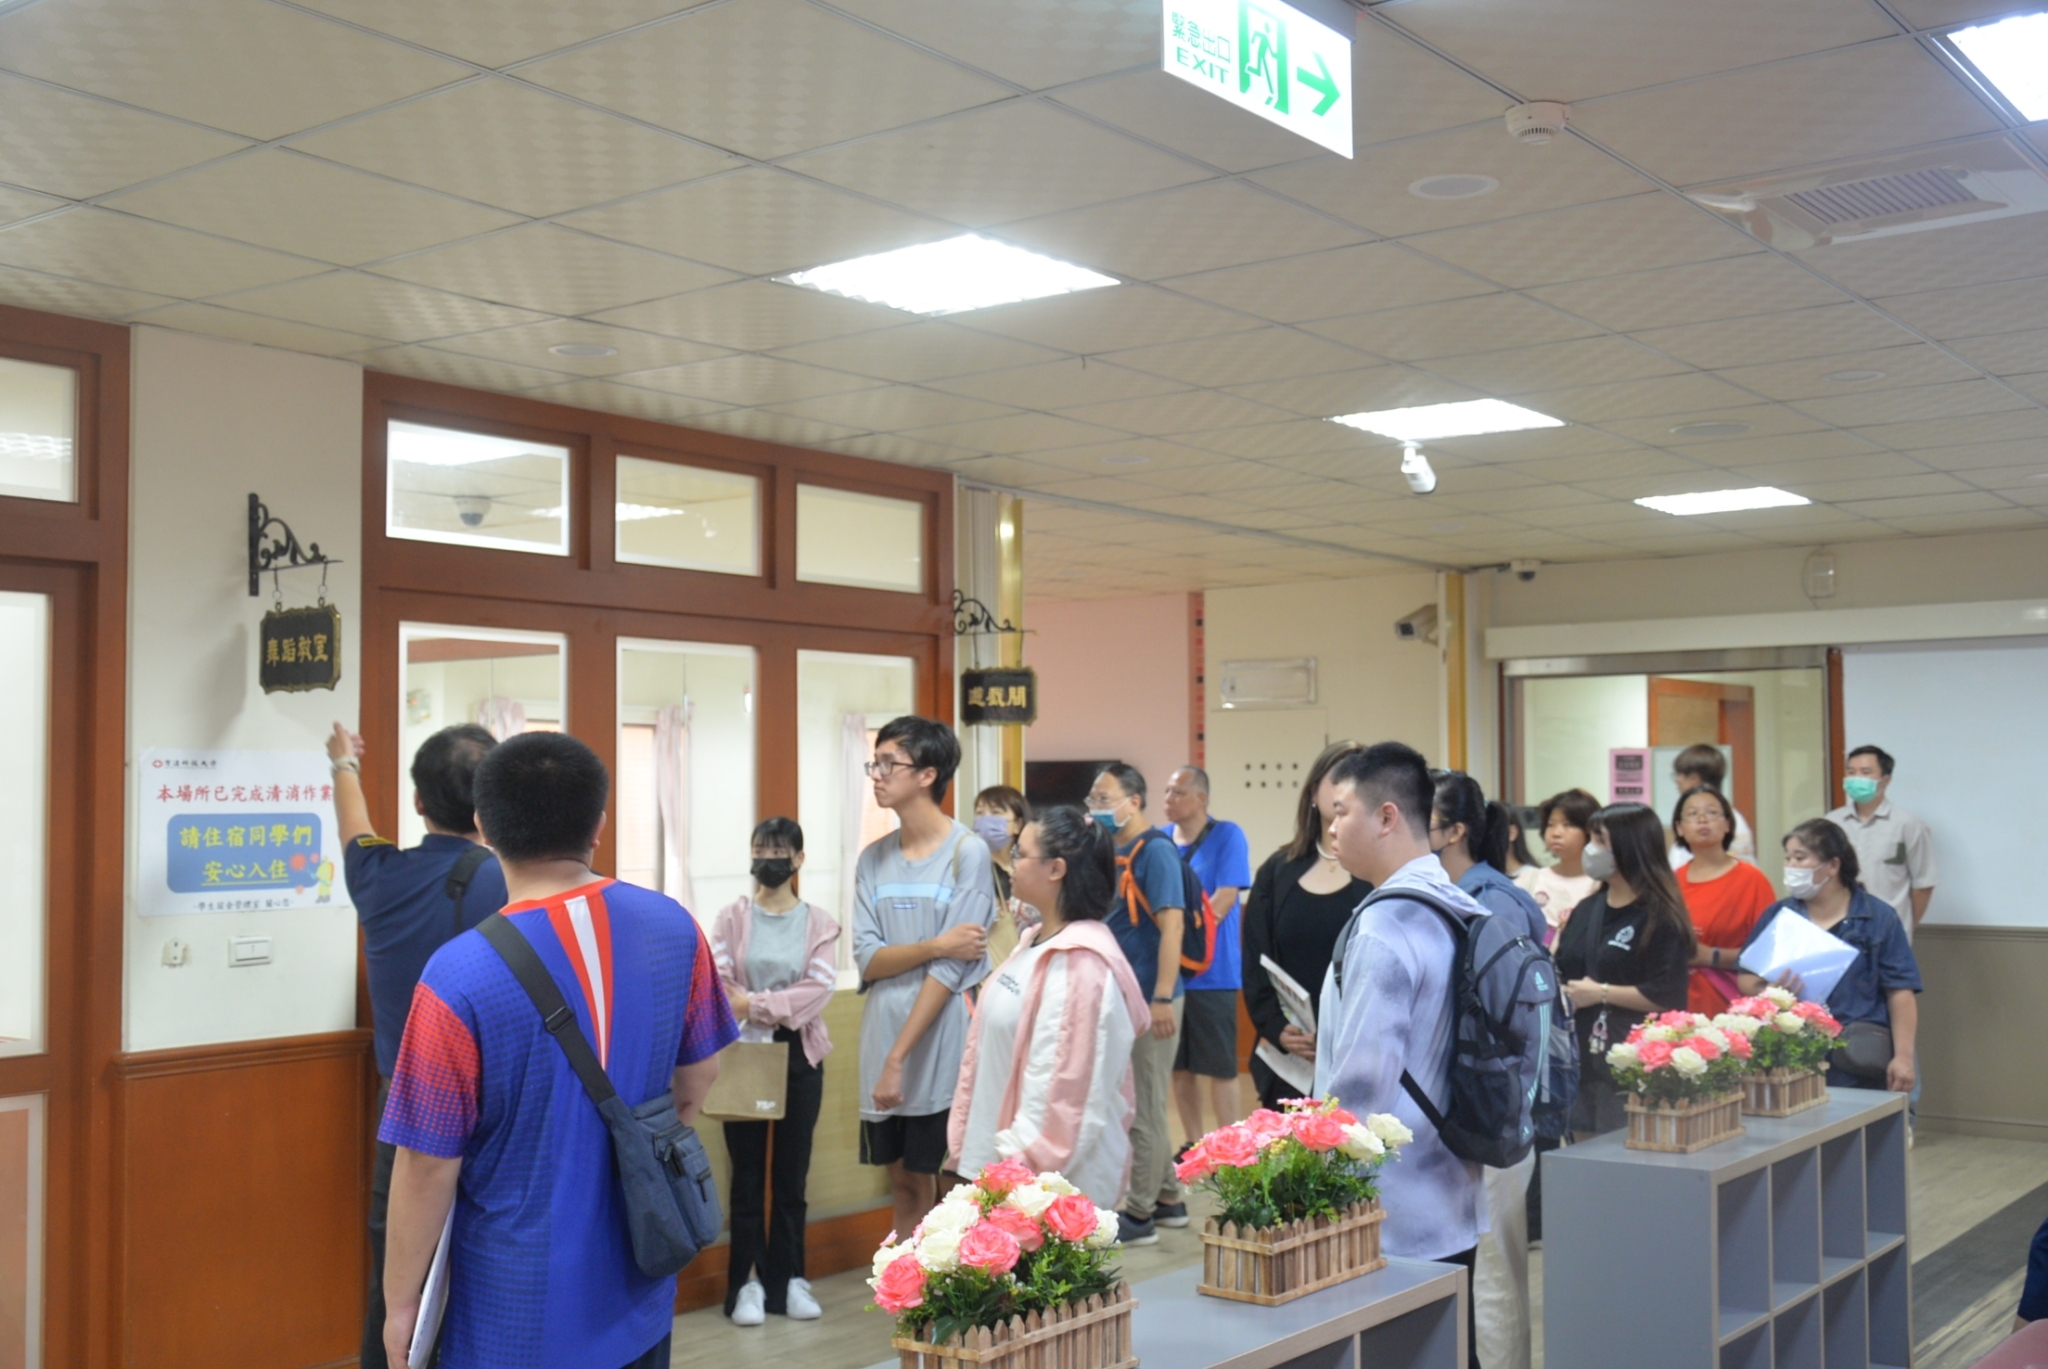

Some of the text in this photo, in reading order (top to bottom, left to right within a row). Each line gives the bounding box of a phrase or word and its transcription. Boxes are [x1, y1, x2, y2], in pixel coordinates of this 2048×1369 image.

[1171, 11, 1231, 64] 緊急出口
[1176, 46, 1229, 84] EXIT
[266, 633, 329, 667] 舞蹈教室
[157, 784, 333, 803] 本場所已完成清消作業
[179, 824, 313, 849] 請住宿同學們
[202, 860, 289, 883] 安心入住
